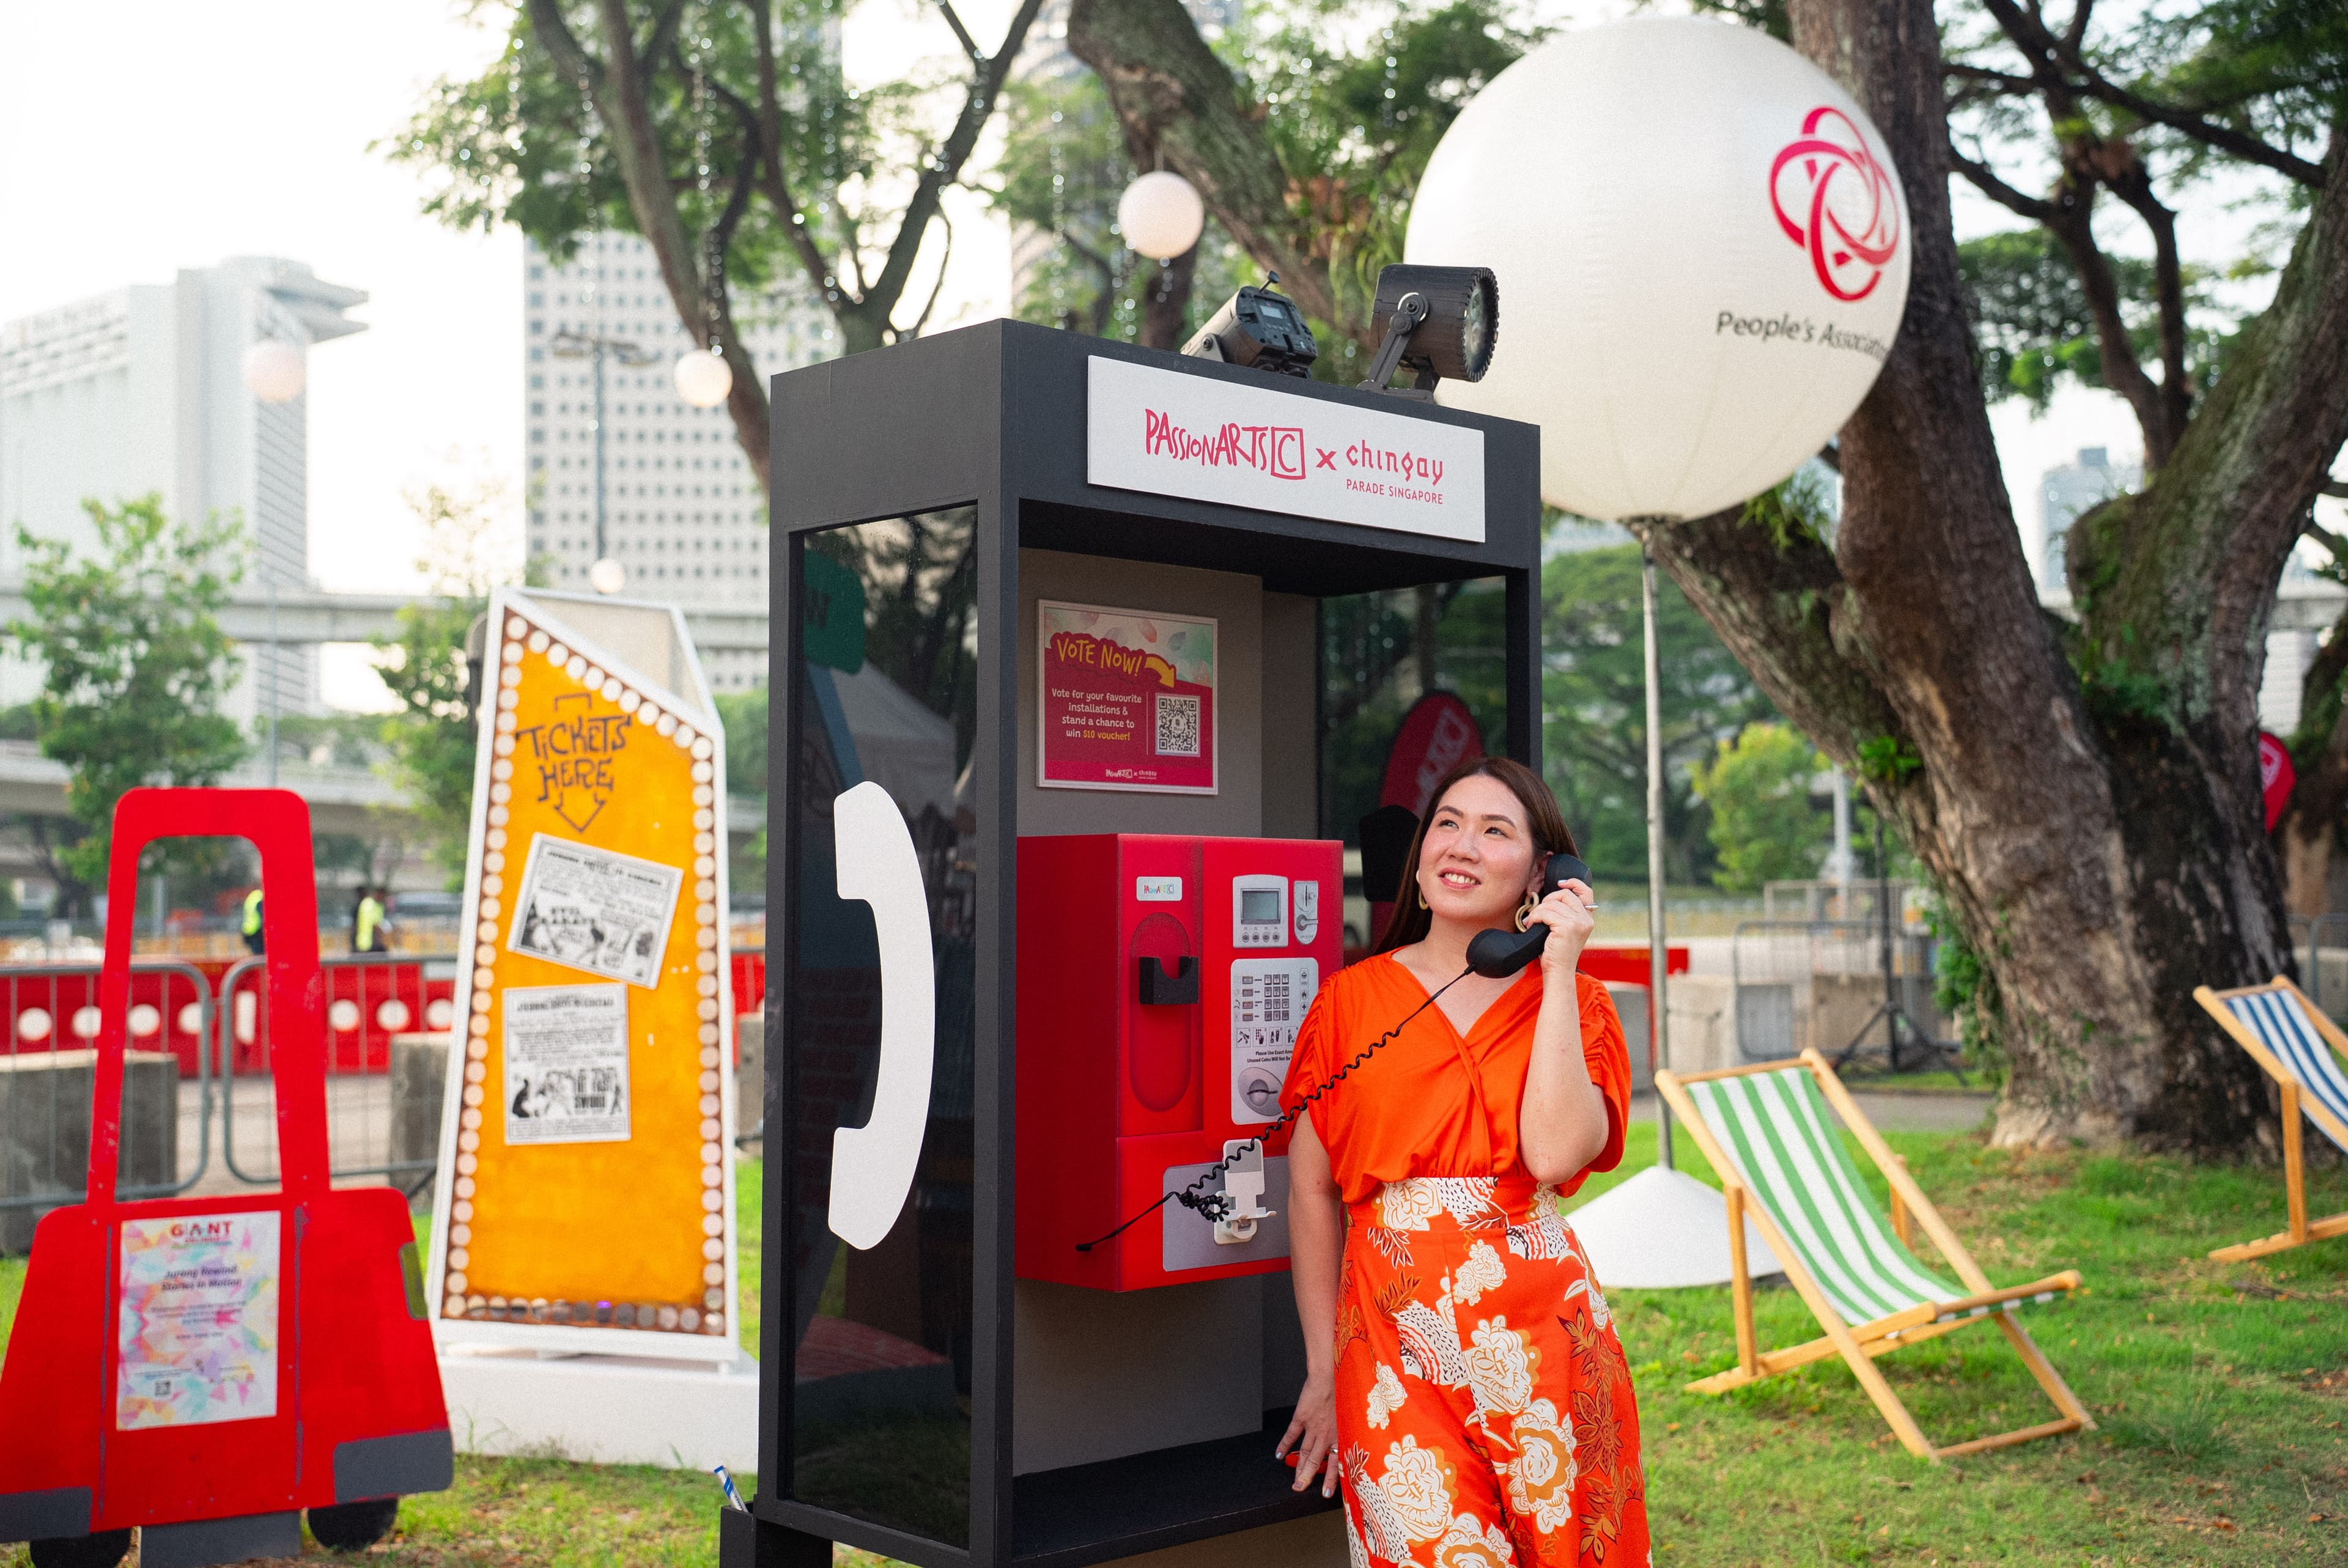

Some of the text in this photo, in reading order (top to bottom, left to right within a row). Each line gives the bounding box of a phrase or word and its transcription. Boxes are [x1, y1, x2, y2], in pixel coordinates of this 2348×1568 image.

[1716, 311, 1816, 344] People's
[1346, 439, 1443, 487] chingay
[1346, 479, 1443, 504] PARADE SINGAPORE
[1057, 638, 1142, 677] VOTE NOW!
[1052, 688, 1142, 703] Vote for your favourite
[1068, 702, 1128, 715] installations &
[1061, 715, 1086, 725] stand
[1096, 717, 1124, 727] chance
[1126, 719, 1135, 729] to
[1066, 729, 1131, 741] win $10 voucher!
[515, 714, 632, 760] TICKETS
[537, 757, 615, 803] HERE
